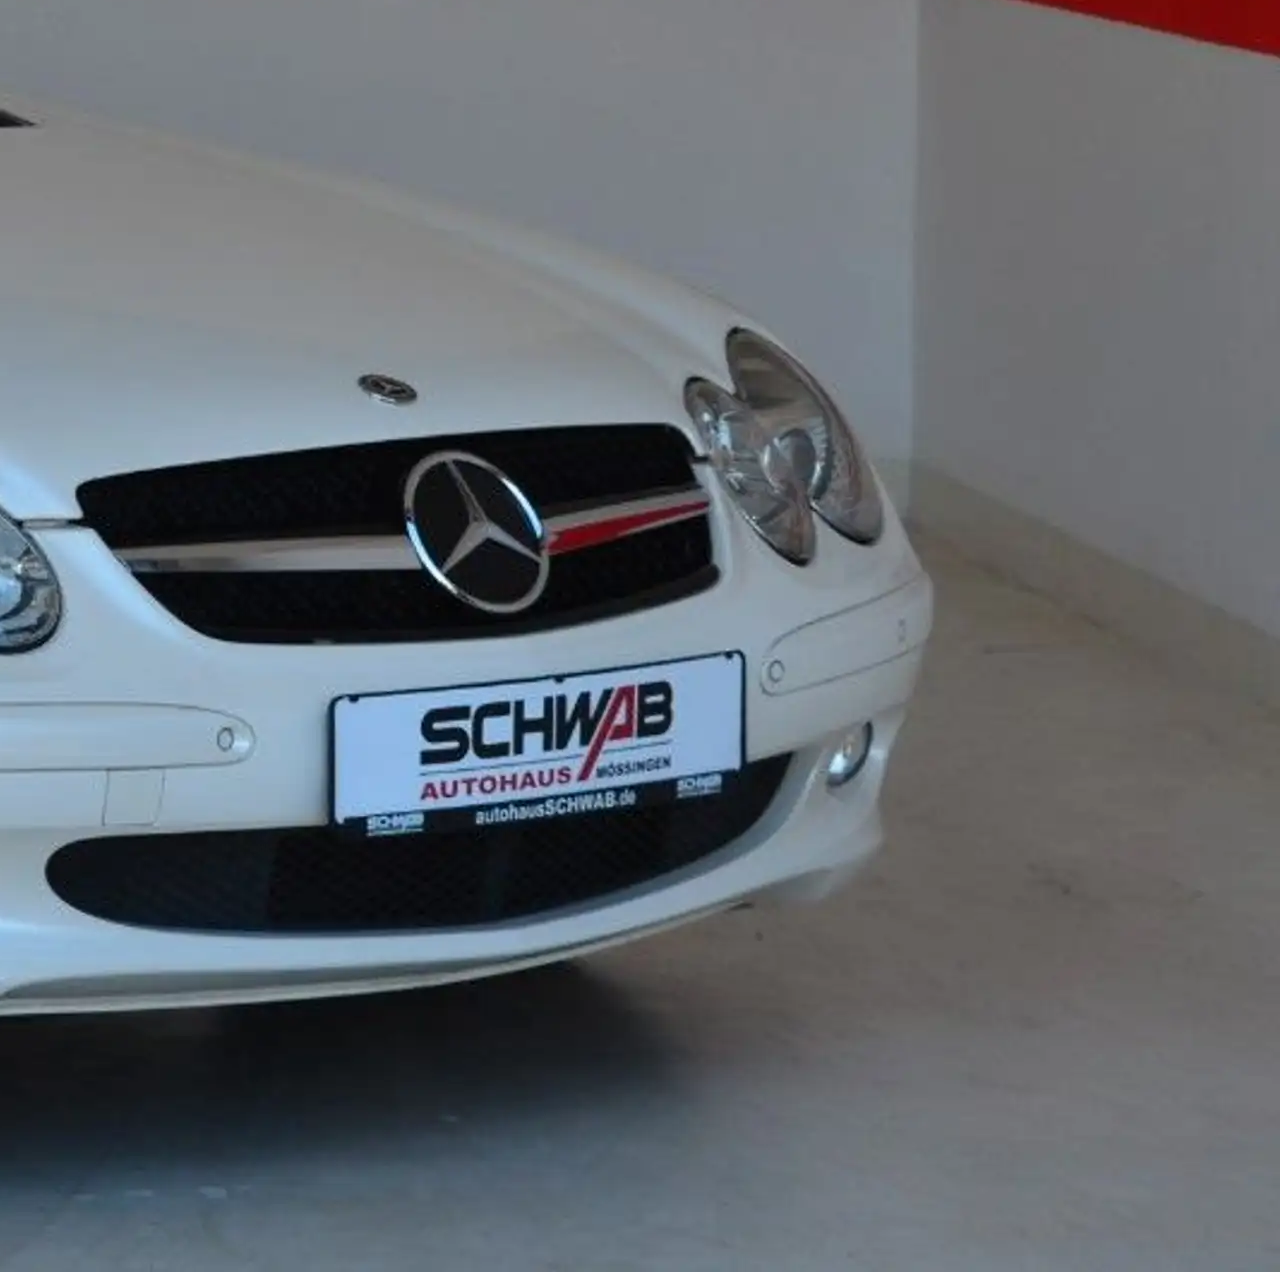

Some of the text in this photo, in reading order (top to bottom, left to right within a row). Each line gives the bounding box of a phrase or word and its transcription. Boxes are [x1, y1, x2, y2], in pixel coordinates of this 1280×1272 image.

[420, 681, 673, 781] SCHWAB
[420, 767, 572, 800] AUTOHAUS
[475, 789, 637, 825] autohausSCHWAB.de
